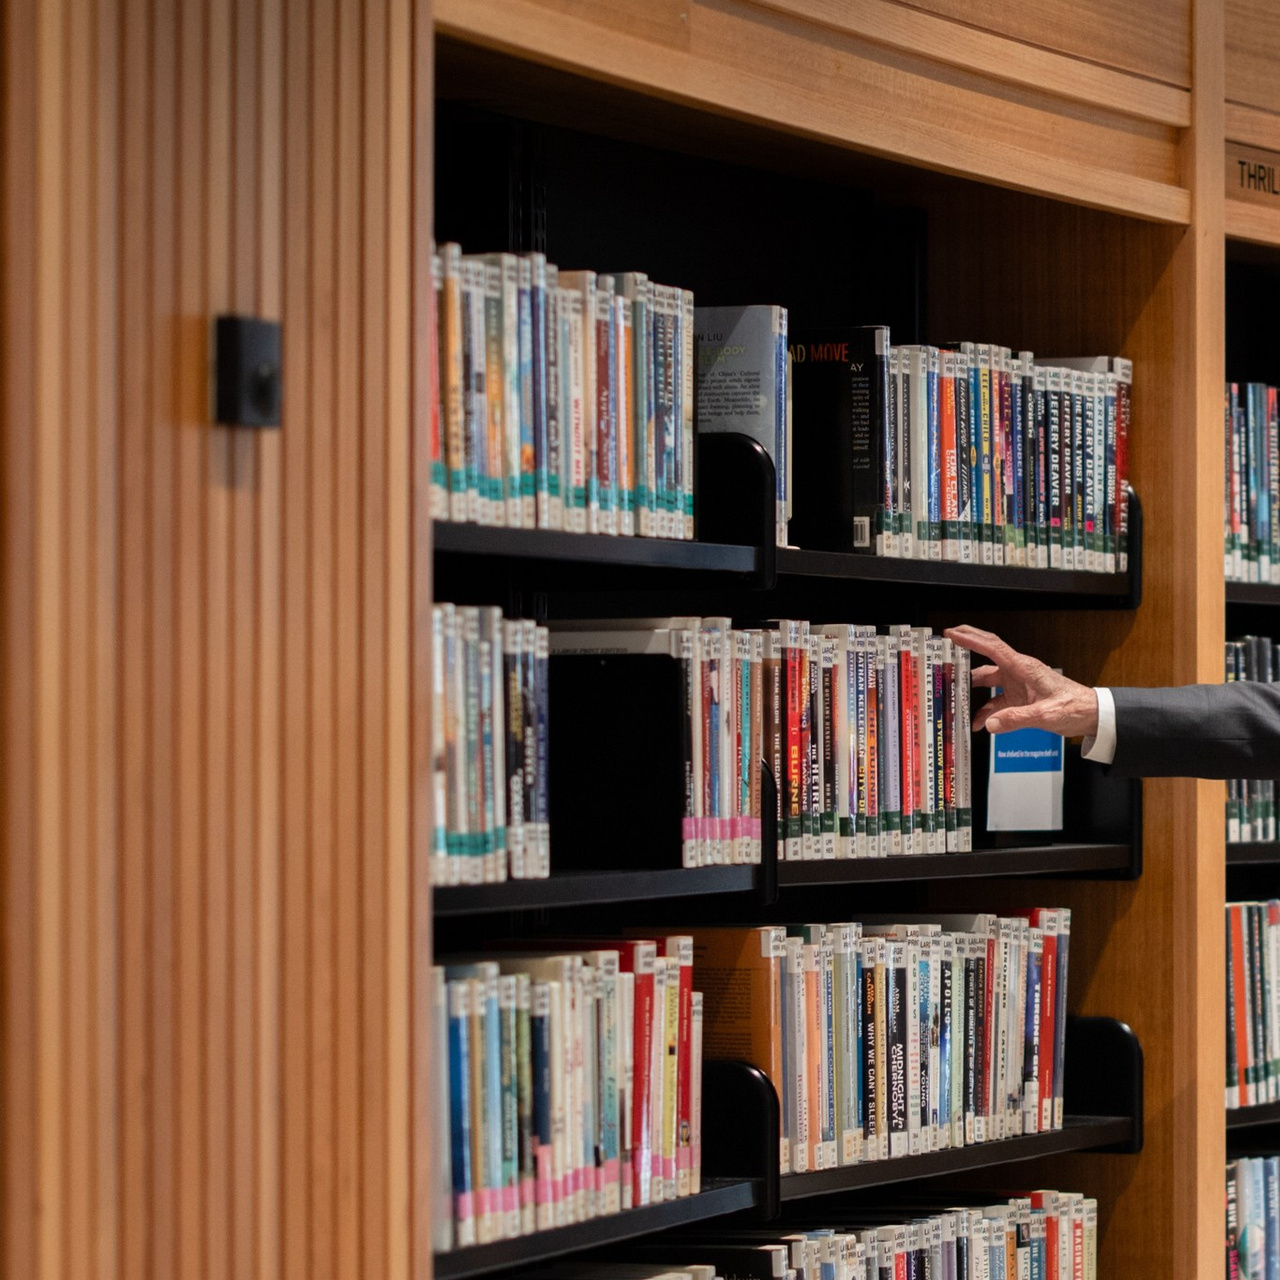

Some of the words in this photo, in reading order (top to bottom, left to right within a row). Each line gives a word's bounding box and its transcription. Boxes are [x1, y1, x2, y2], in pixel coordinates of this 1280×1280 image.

[707, 333, 723, 342] LIU
[810, 342, 849, 363] MOVE
[850, 363, 864, 372] AY
[1051, 454, 1059, 507] DEAVER
[1120, 479, 1128, 534] NEVER
[790, 745, 799, 817] BURNE
[968, 972, 976, 997] POWER
[1033, 983, 1041, 1041] THRONE
[867, 1022, 875, 1047] WHY
[968, 1010, 976, 1045] MOMENTS
[867, 1049, 875, 1065] WE
[867, 1068, 875, 1099] CAN'T
[868, 1102, 876, 1135] SLEEP
[1227, 1180, 1238, 1201] THE
[1227, 1205, 1238, 1229] HIVE
